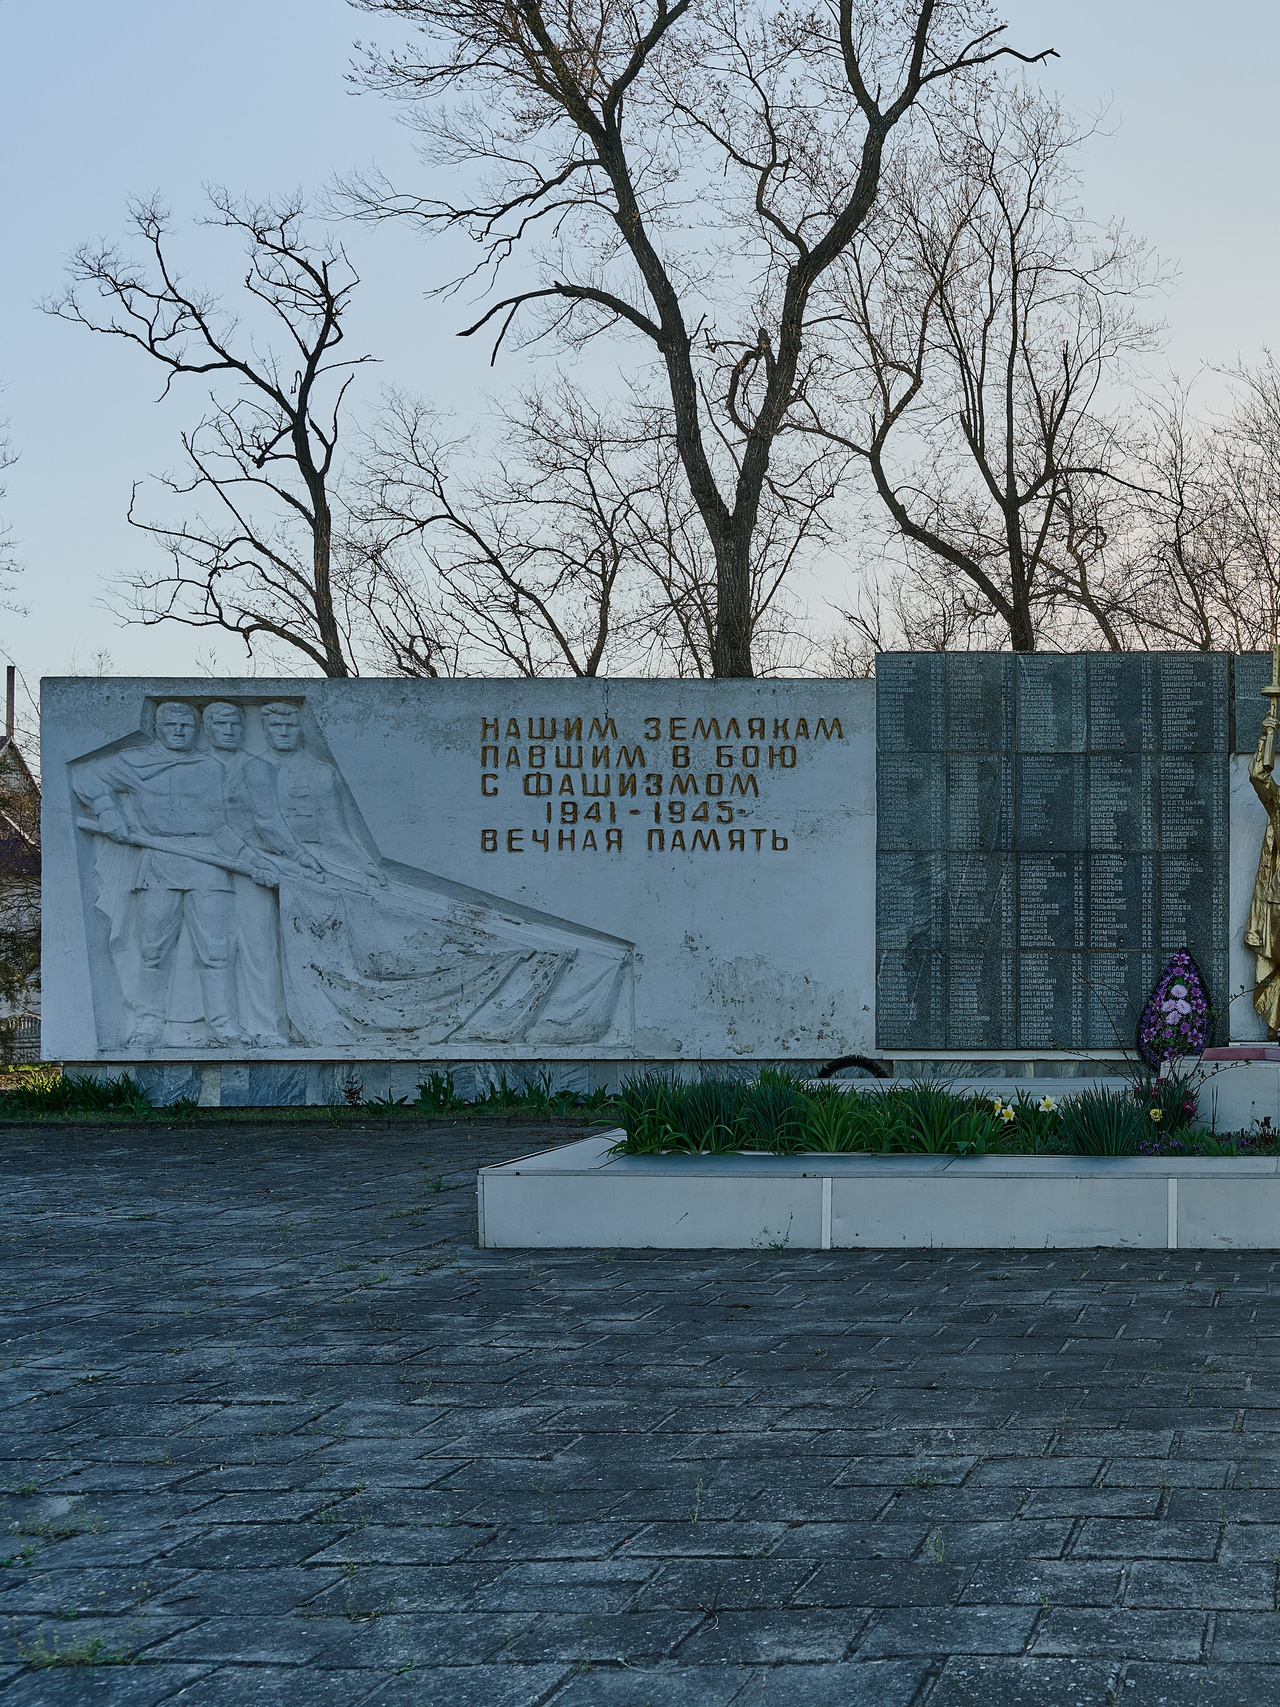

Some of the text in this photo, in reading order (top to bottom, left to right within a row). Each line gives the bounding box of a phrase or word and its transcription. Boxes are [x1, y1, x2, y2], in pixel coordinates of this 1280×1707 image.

[482, 718, 845, 742] НАШИМ ЗЕМЛЯКАМ
[481, 746, 798, 770] ПАВШИМ В БОЮ
[482, 773, 760, 798] С ФАШИЗМОМ
[482, 829, 789, 854] ВЕЧНАЯ ПАМЯТЬ
